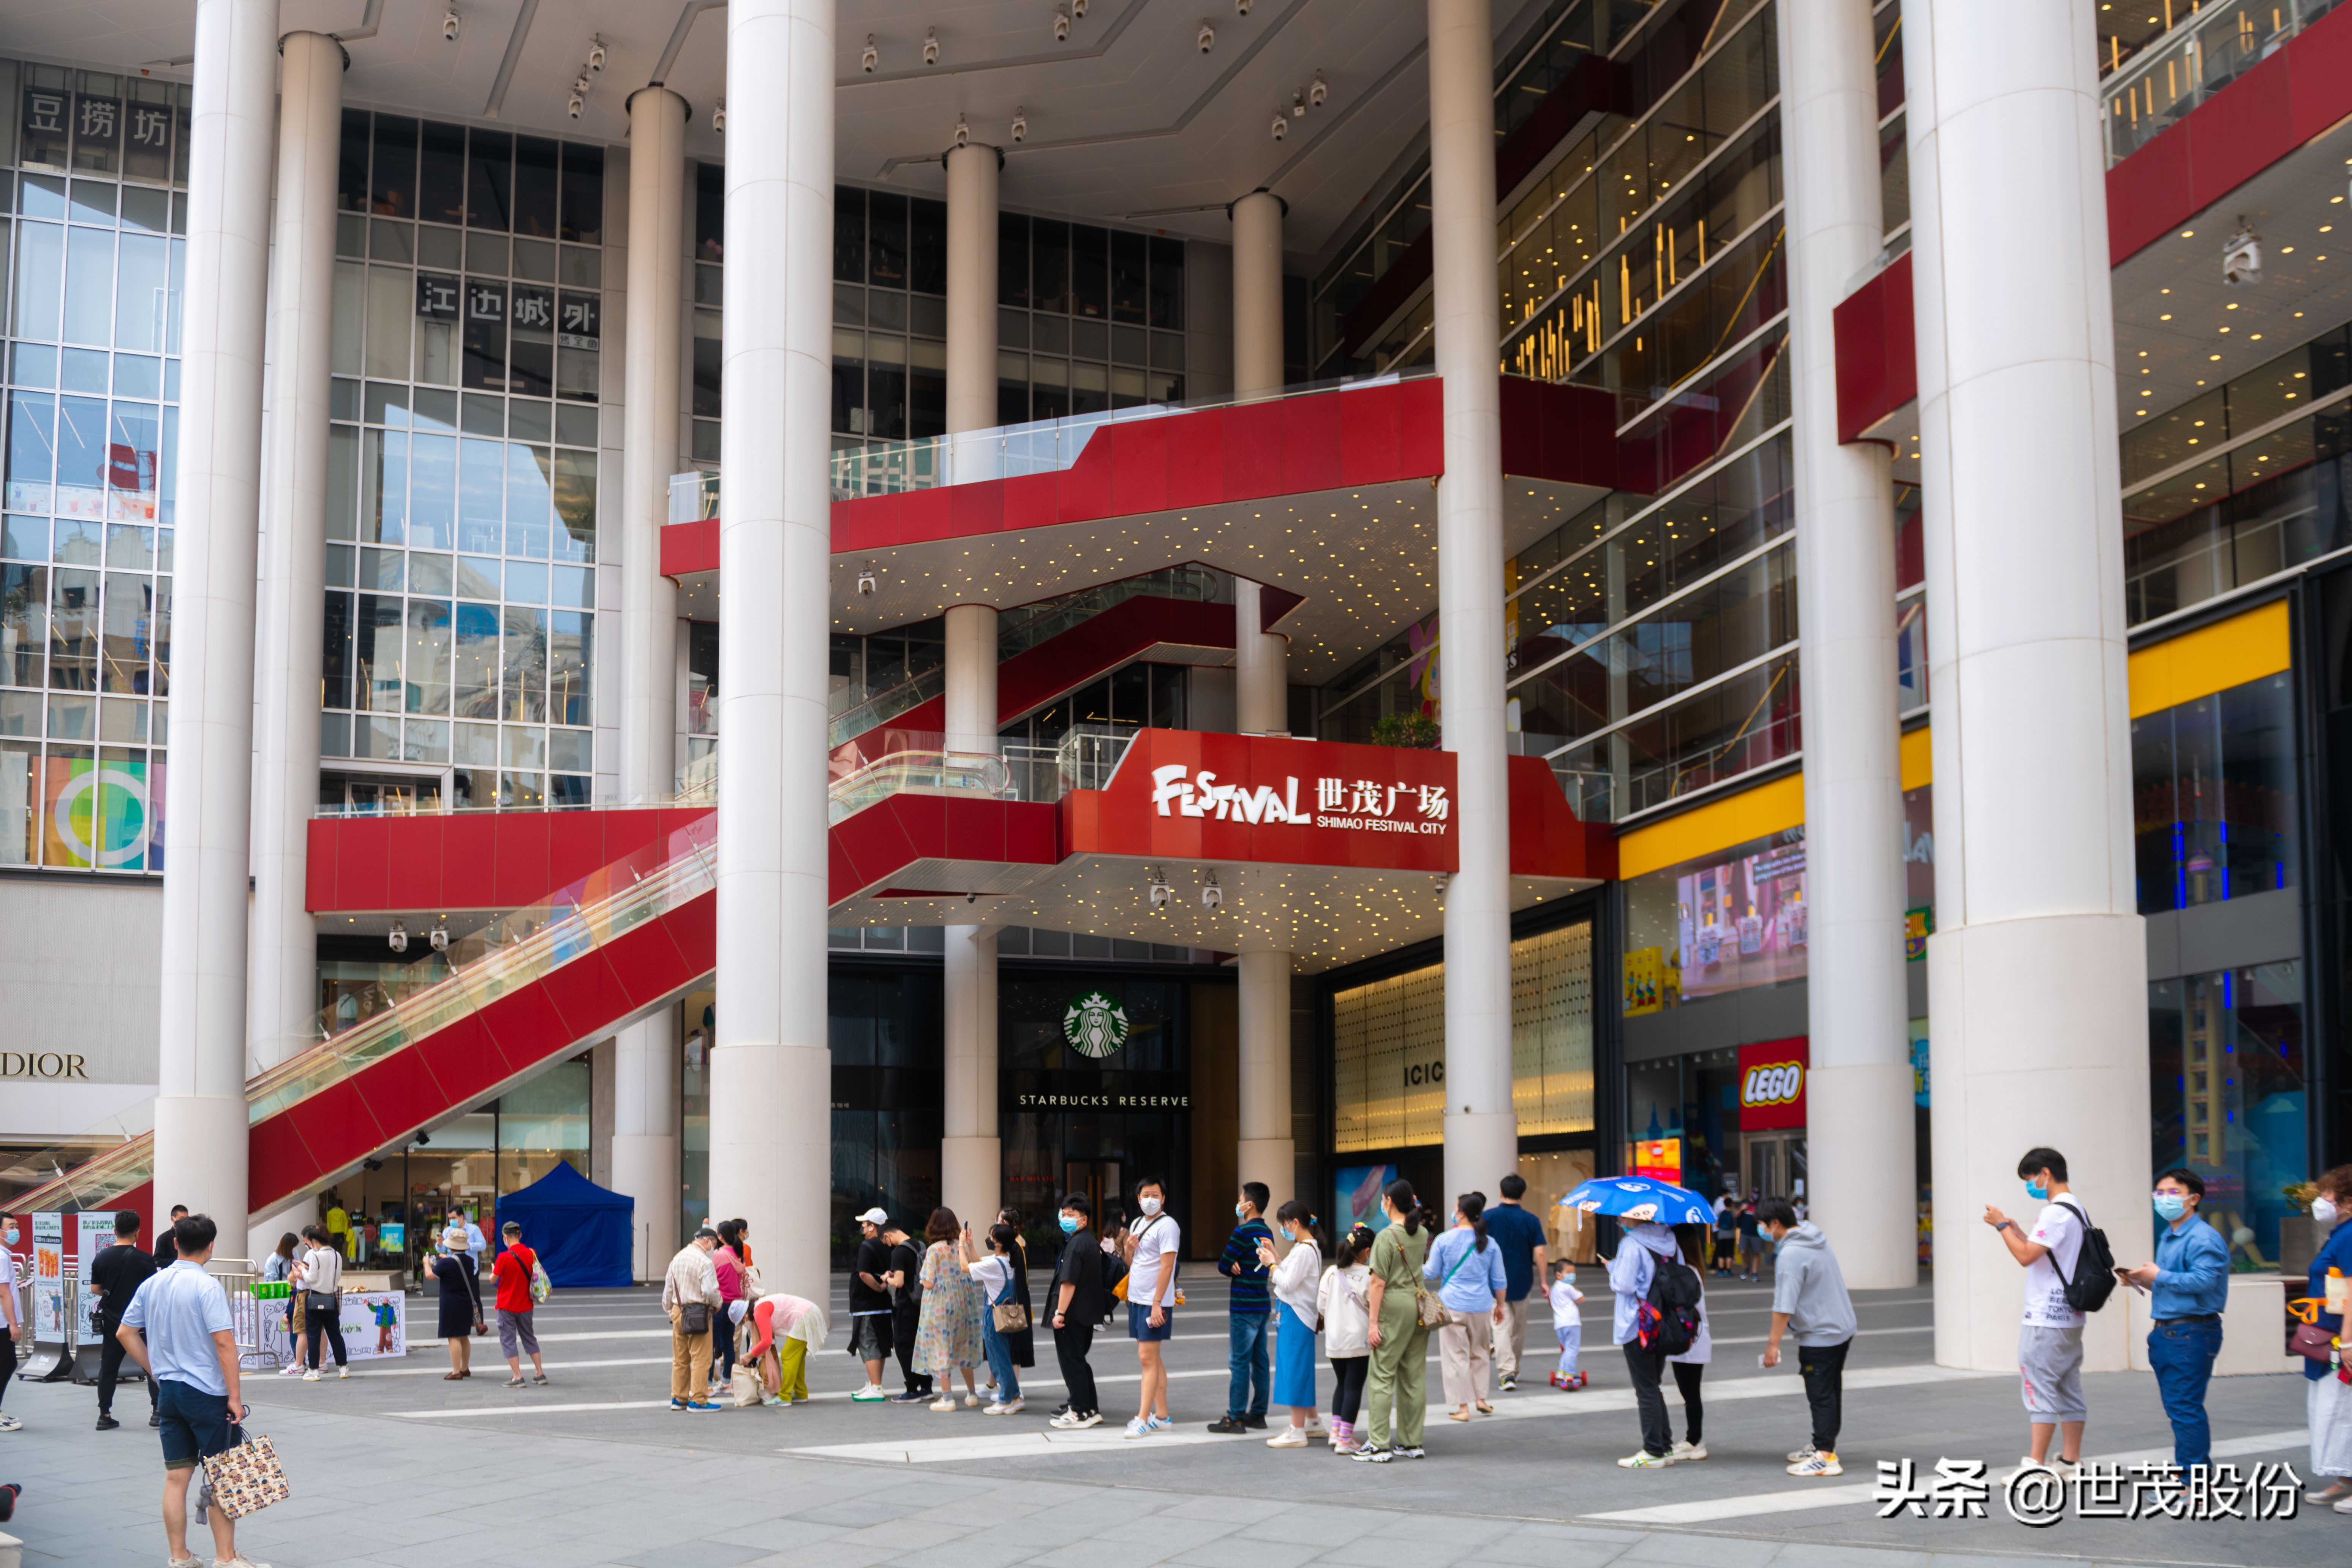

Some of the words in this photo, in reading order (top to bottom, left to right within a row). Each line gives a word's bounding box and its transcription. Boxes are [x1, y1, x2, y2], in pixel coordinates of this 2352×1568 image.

[29, 93, 168, 147] 豆捞坊
[422, 282, 595, 332] 江边城外
[1152, 764, 1311, 825] FESTIVAL
[1314, 777, 1449, 820] 世茂广场
[1317, 816, 1363, 830] SHIMAO
[1366, 819, 1418, 833] FESTIVAL
[1421, 822, 1446, 835] CITY
[0, 1053, 89, 1078] DIOR
[1744, 1065, 1799, 1104] LEGO
[1020, 1095, 1109, 1106] STARBUCKS
[1119, 1097, 1189, 1106] RESERVE
[2046, 1313, 2071, 1321] PARIS
